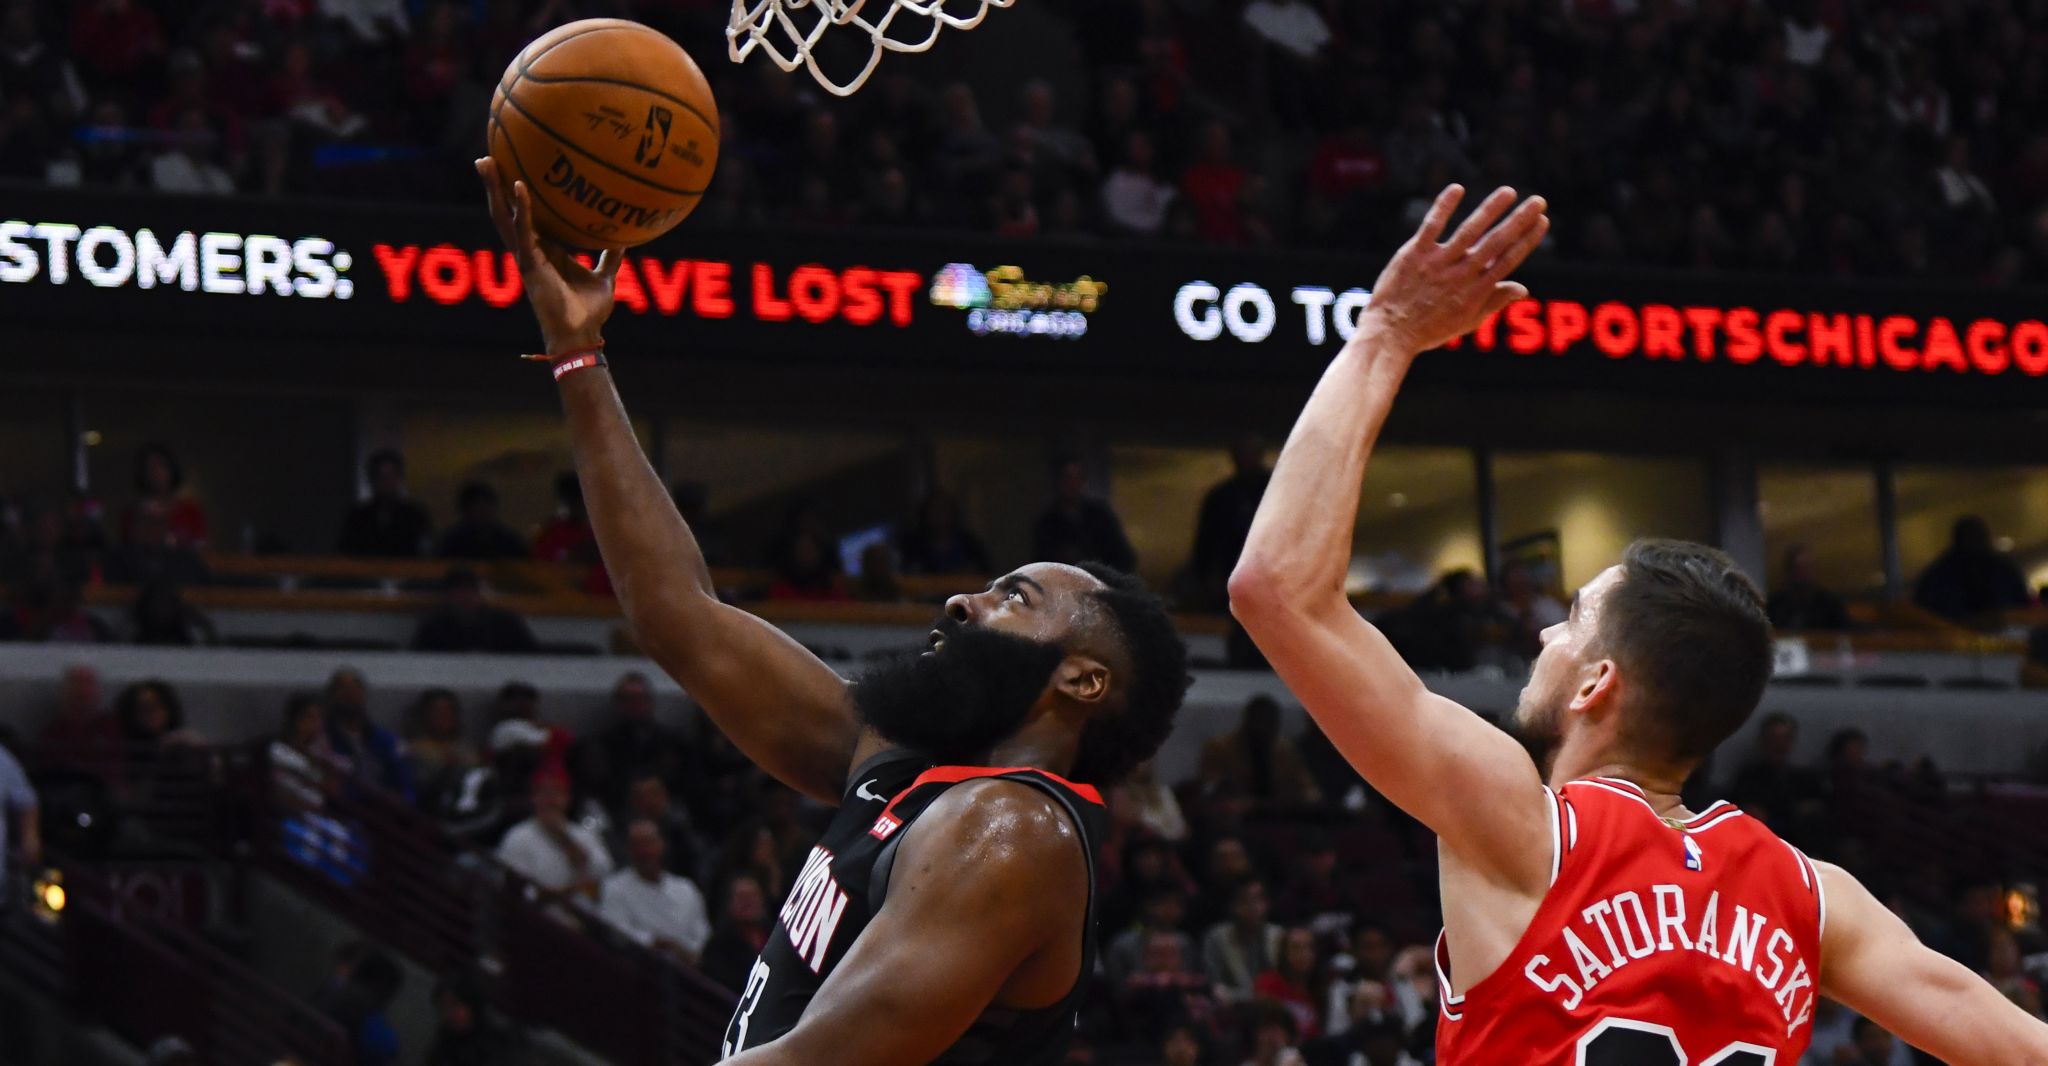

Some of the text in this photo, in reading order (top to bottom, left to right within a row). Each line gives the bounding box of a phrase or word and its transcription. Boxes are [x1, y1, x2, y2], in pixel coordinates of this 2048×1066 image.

[0, 220, 354, 299] STOMERS:
[372, 243, 523, 307] YOU
[574, 254, 735, 319] AVE
[752, 262, 922, 328] LOST
[1174, 280, 1276, 343] GO
[1445, 297, 2048, 376] YSPORTSCHICAGO
[1524, 884, 1813, 1039] SATORANSKY
